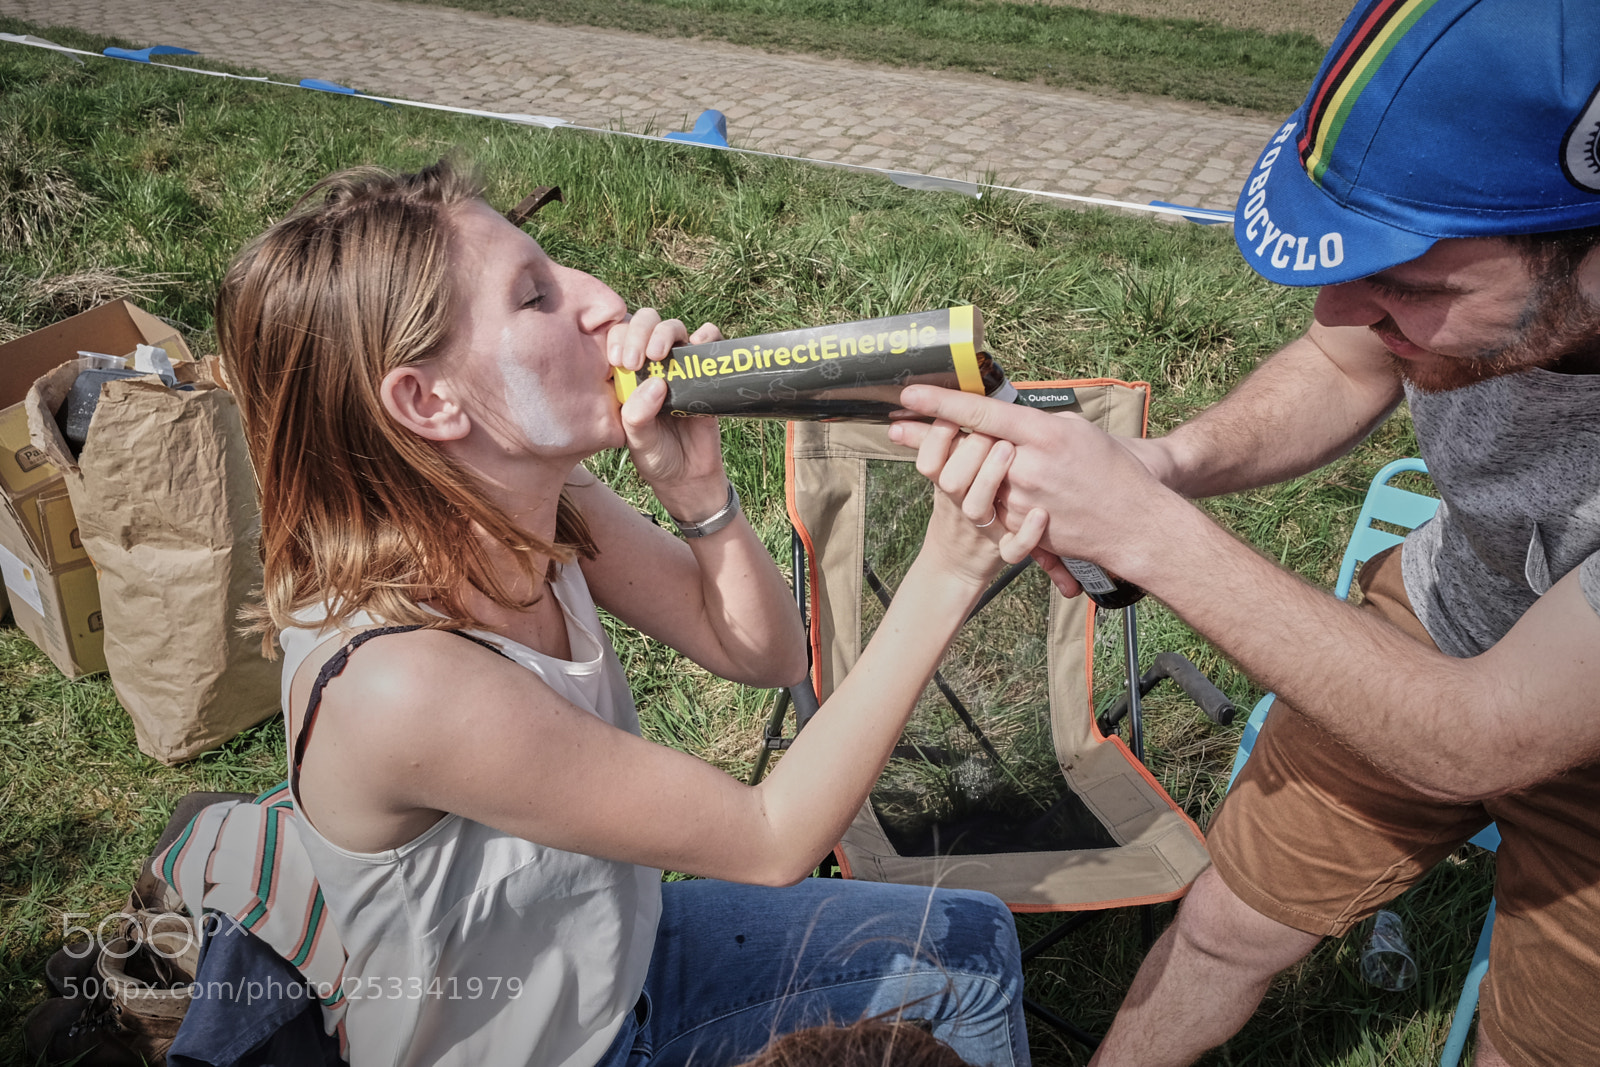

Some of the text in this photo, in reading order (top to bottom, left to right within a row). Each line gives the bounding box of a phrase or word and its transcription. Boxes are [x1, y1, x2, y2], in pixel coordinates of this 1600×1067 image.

[1243, 121, 1344, 271] ROBOCYCLO
[647, 322, 937, 382] #AllezDirectEnergie
[1028, 394, 1069, 402] Quechua
